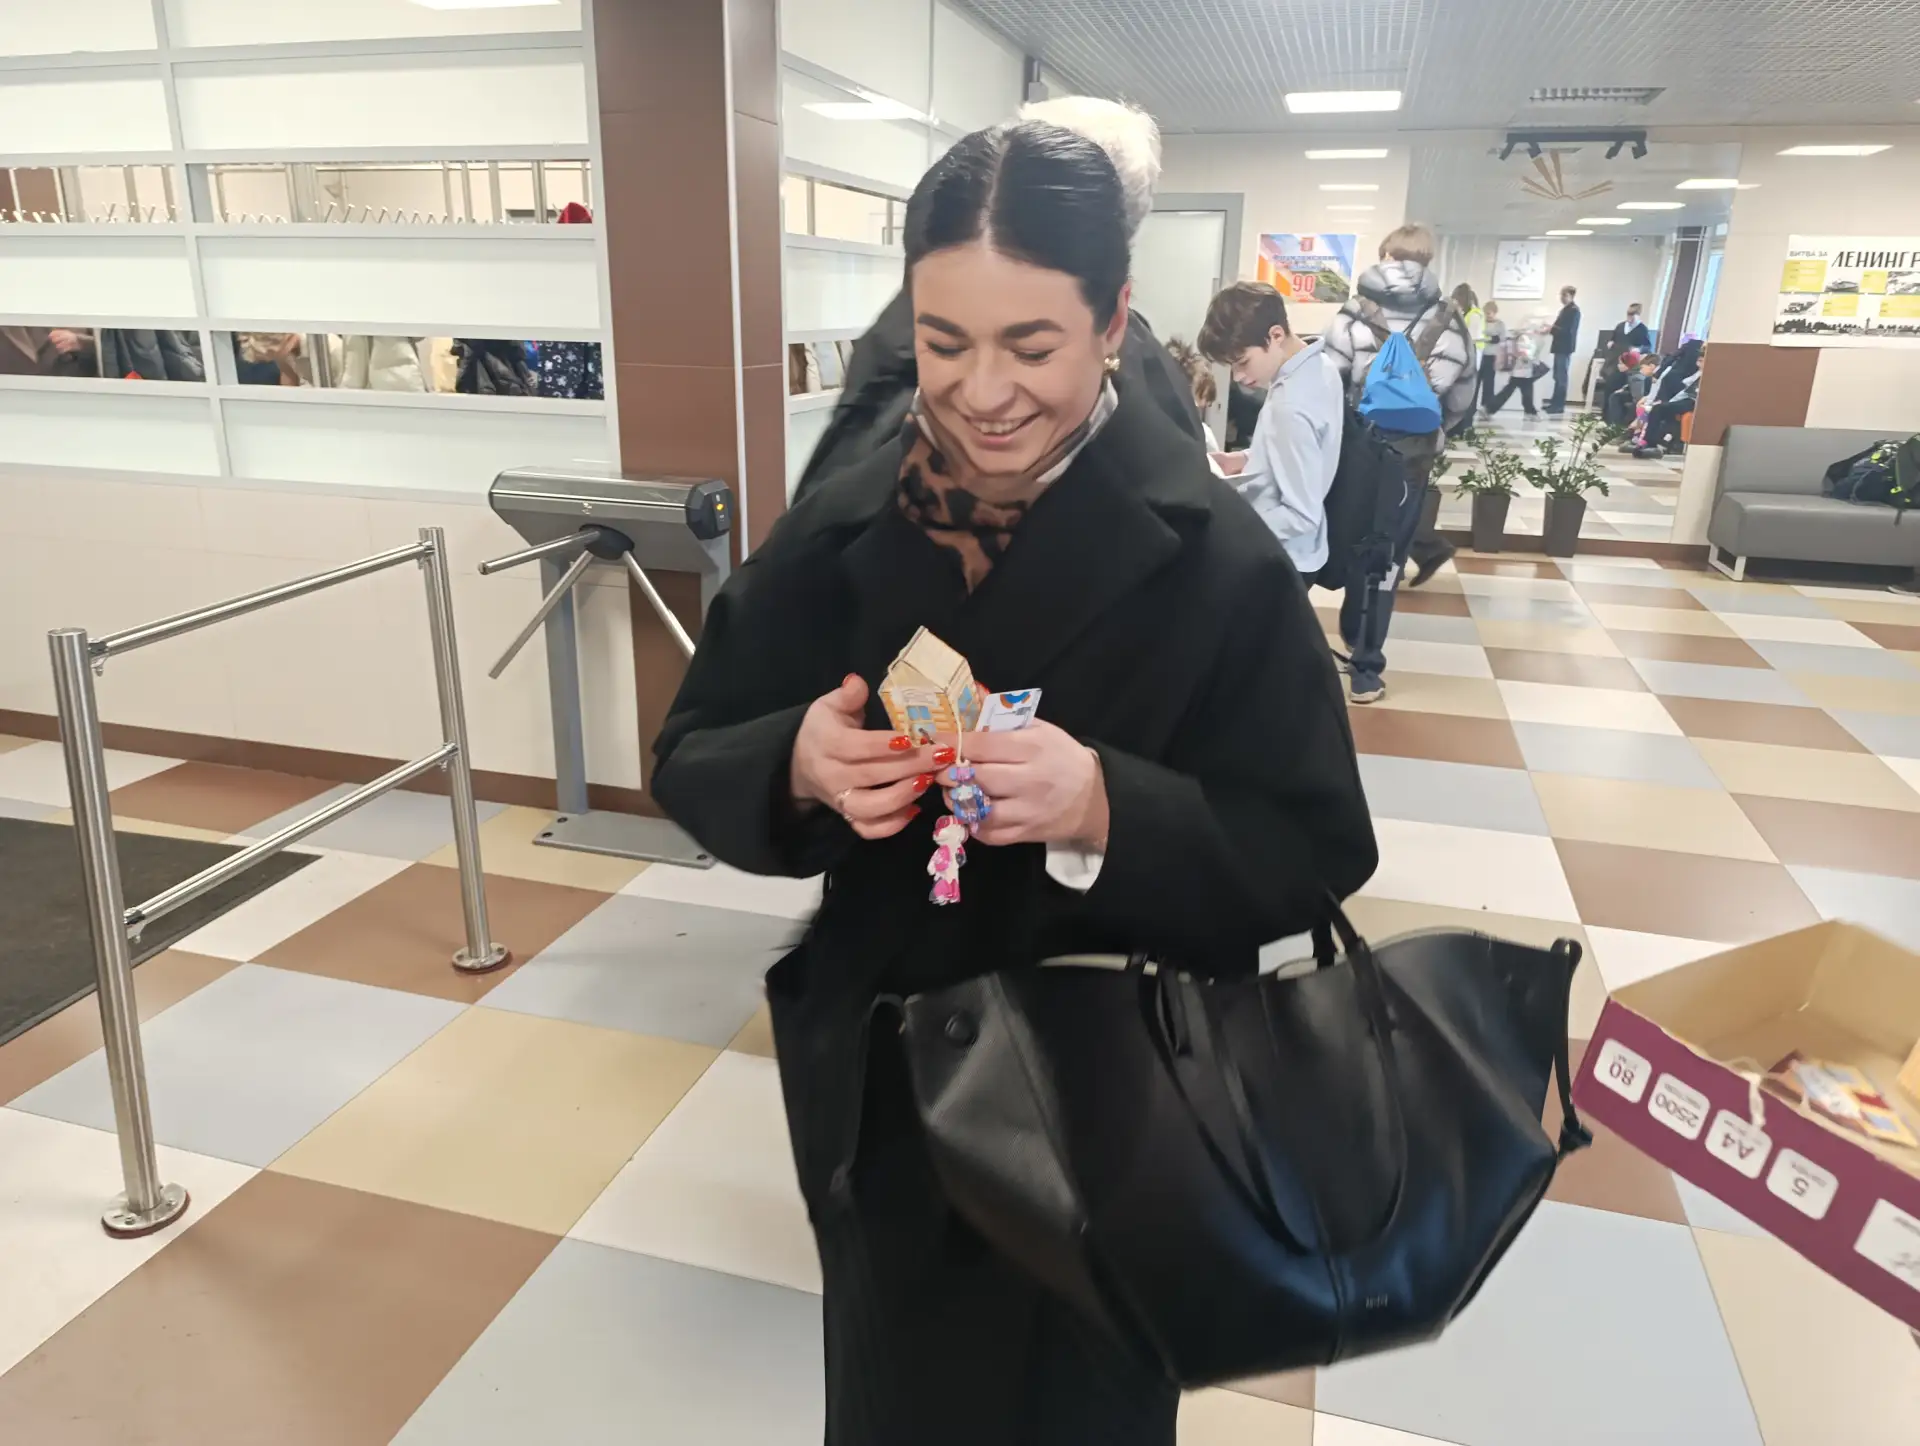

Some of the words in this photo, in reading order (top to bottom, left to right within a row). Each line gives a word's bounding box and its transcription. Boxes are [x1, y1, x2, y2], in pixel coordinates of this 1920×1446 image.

[1292, 275, 1315, 293] 90
[1608, 1064, 1635, 1087] 80
[1655, 1092, 1700, 1129] 2500
[1791, 1176, 1810, 1198] 5
